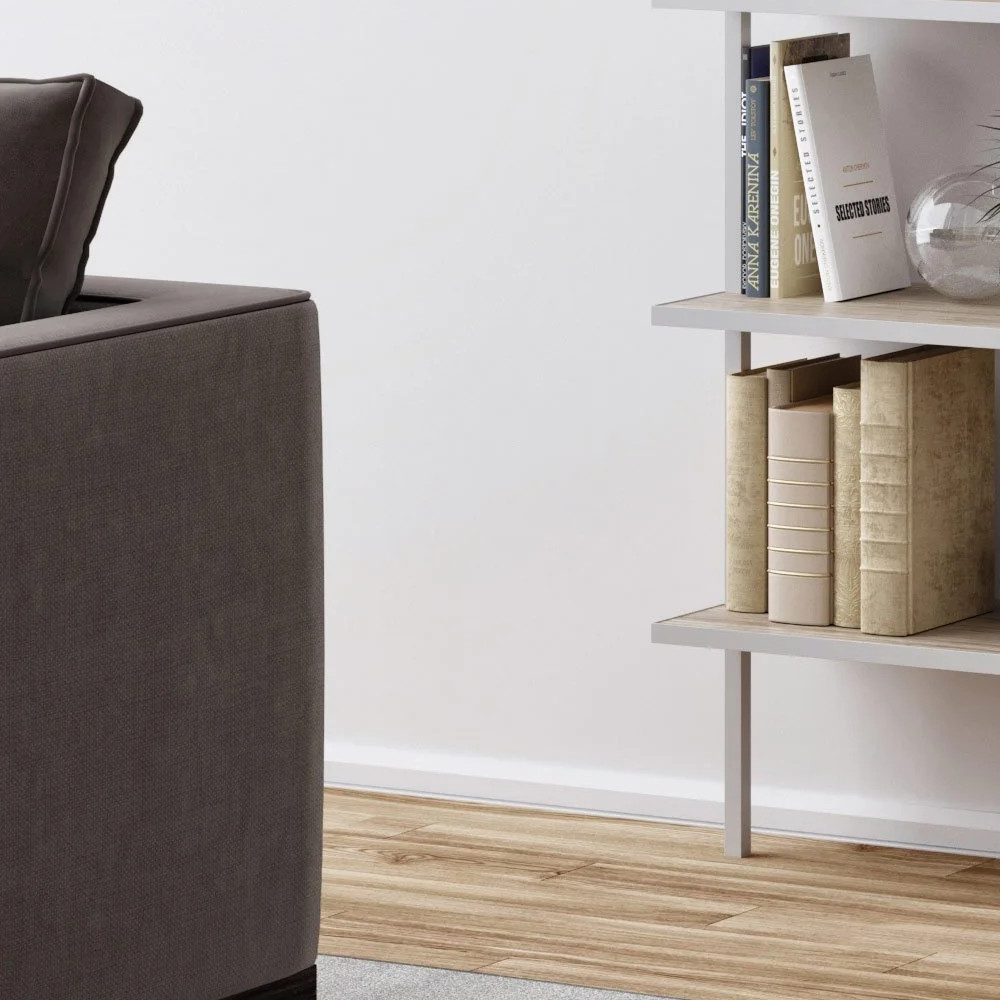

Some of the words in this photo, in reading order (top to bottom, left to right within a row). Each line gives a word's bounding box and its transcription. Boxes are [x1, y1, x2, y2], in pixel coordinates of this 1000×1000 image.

[792, 87, 807, 142] STORIES
[747, 152, 759, 238] KARENINA
[770, 169, 779, 226] ONEGIN
[803, 152, 820, 215] SELECTED
[835, 201, 865, 222] SELECTED
[864, 196, 891, 216] STORIES
[747, 241, 759, 291] ANNA
[770, 230, 779, 289] EUGENE
